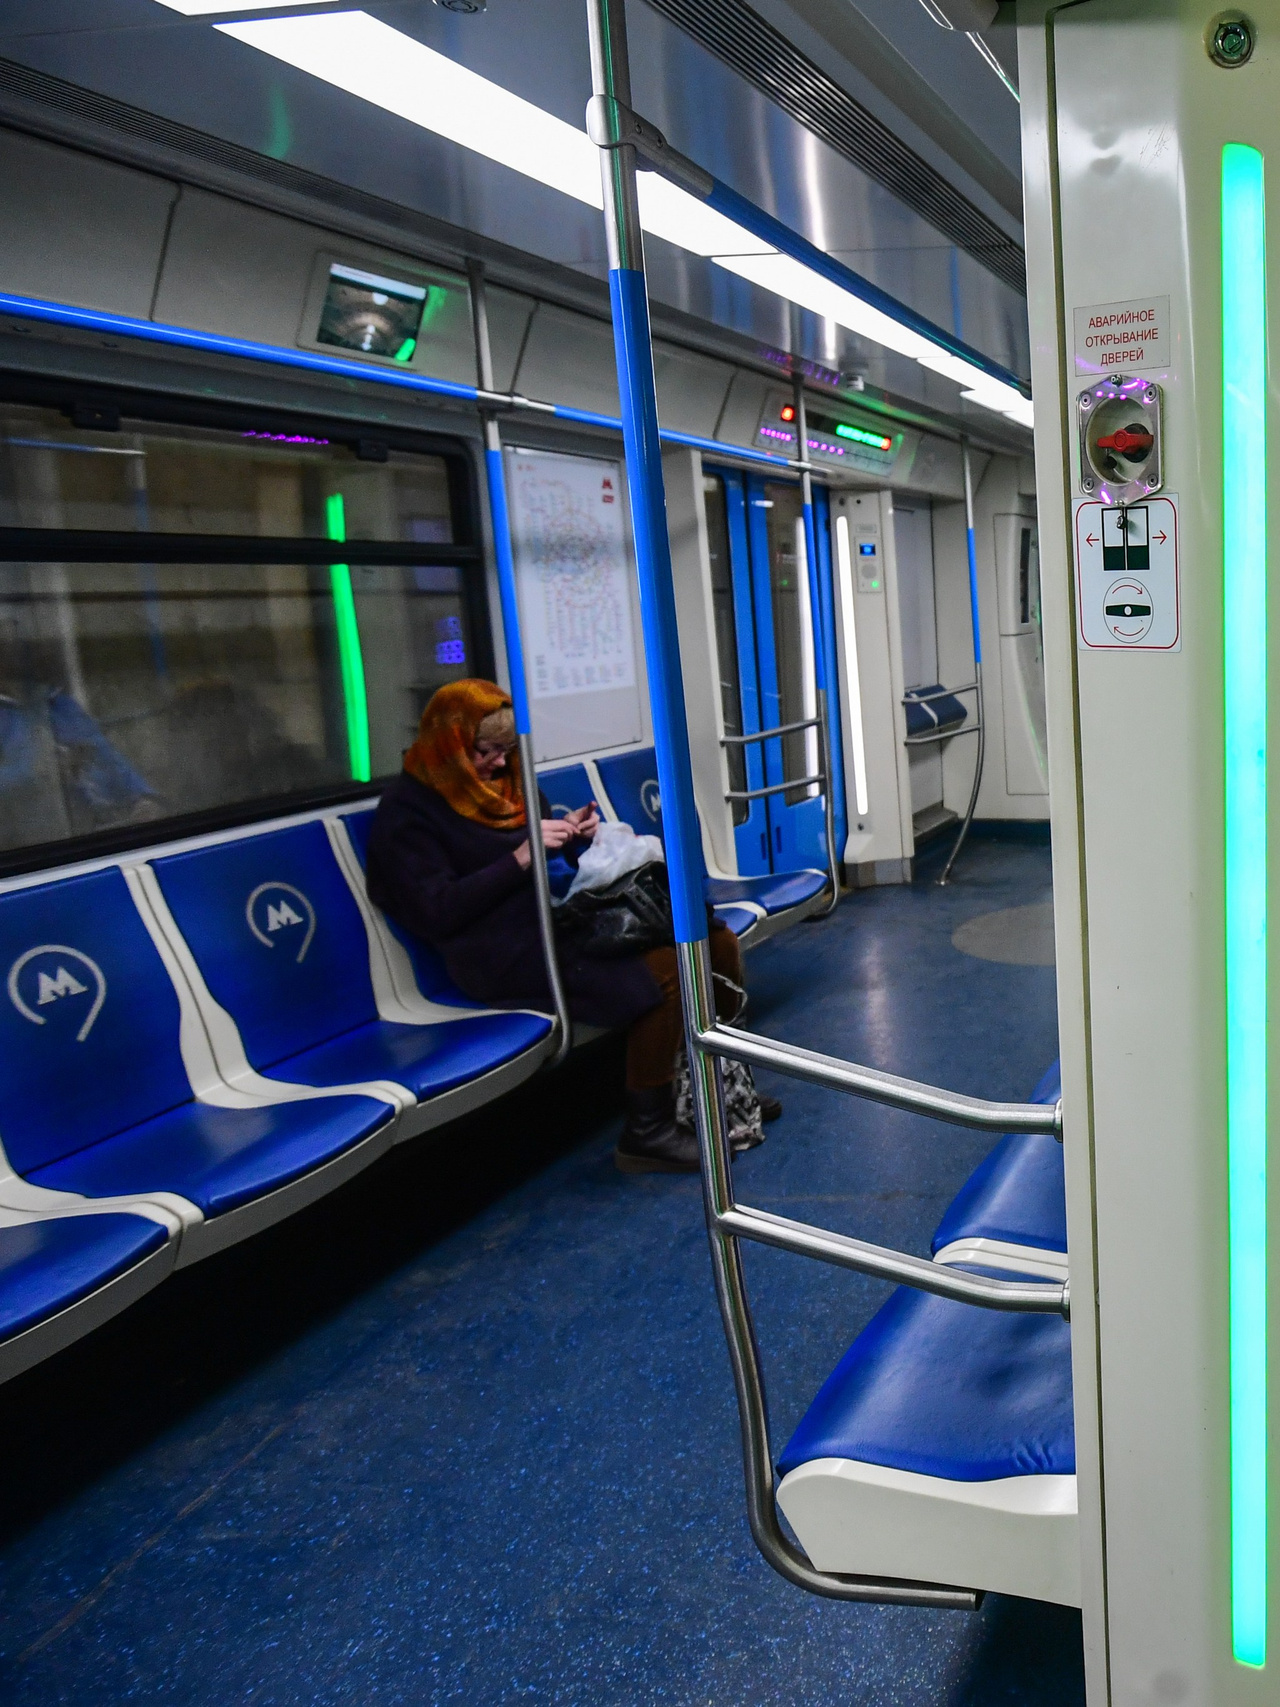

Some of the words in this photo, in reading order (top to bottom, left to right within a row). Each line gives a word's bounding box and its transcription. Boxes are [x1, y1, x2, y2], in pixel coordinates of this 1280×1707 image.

[1088, 309, 1155, 329] АВАРИЙНОЕ
[1085, 328, 1159, 348] ОТКРЫВАНИЕ
[1100, 347, 1144, 367] ДВЕРЕЙ
